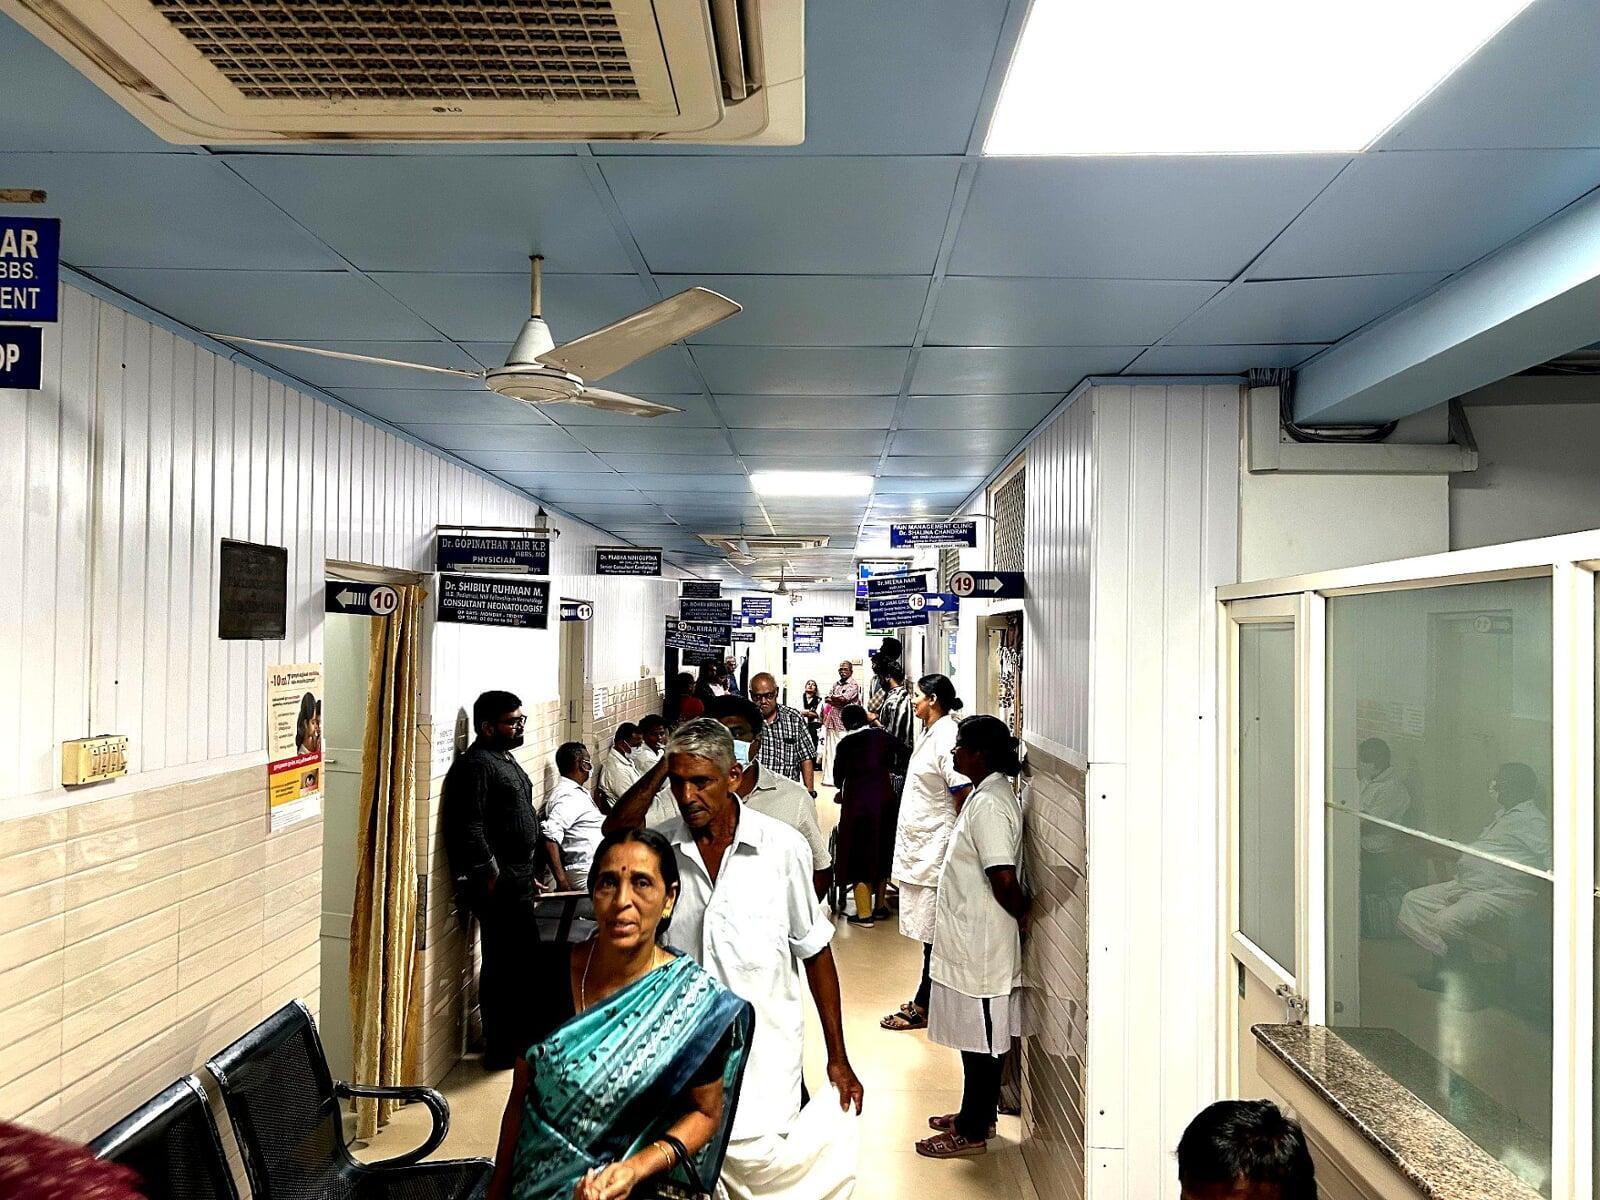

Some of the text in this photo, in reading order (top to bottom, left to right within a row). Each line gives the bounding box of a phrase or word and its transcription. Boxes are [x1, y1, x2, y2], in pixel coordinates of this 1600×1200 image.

[0, 228, 39, 259] AR
[442, 538, 454, 548] Dr.
[455, 538, 509, 549] GOPINATHAN
[510, 540, 531, 551] NAIR
[472, 556, 516, 564] PHYSICIAN
[445, 581, 543, 597] Dr. SHIBILY RUHMAN M.
[954, 577, 972, 591] 19
[374, 592, 394, 609] 10
[443, 598, 544, 613] CONSULTANT NEONATOLOGIST
[911, 597, 923, 607] 18
[579, 607, 590, 617] 11
